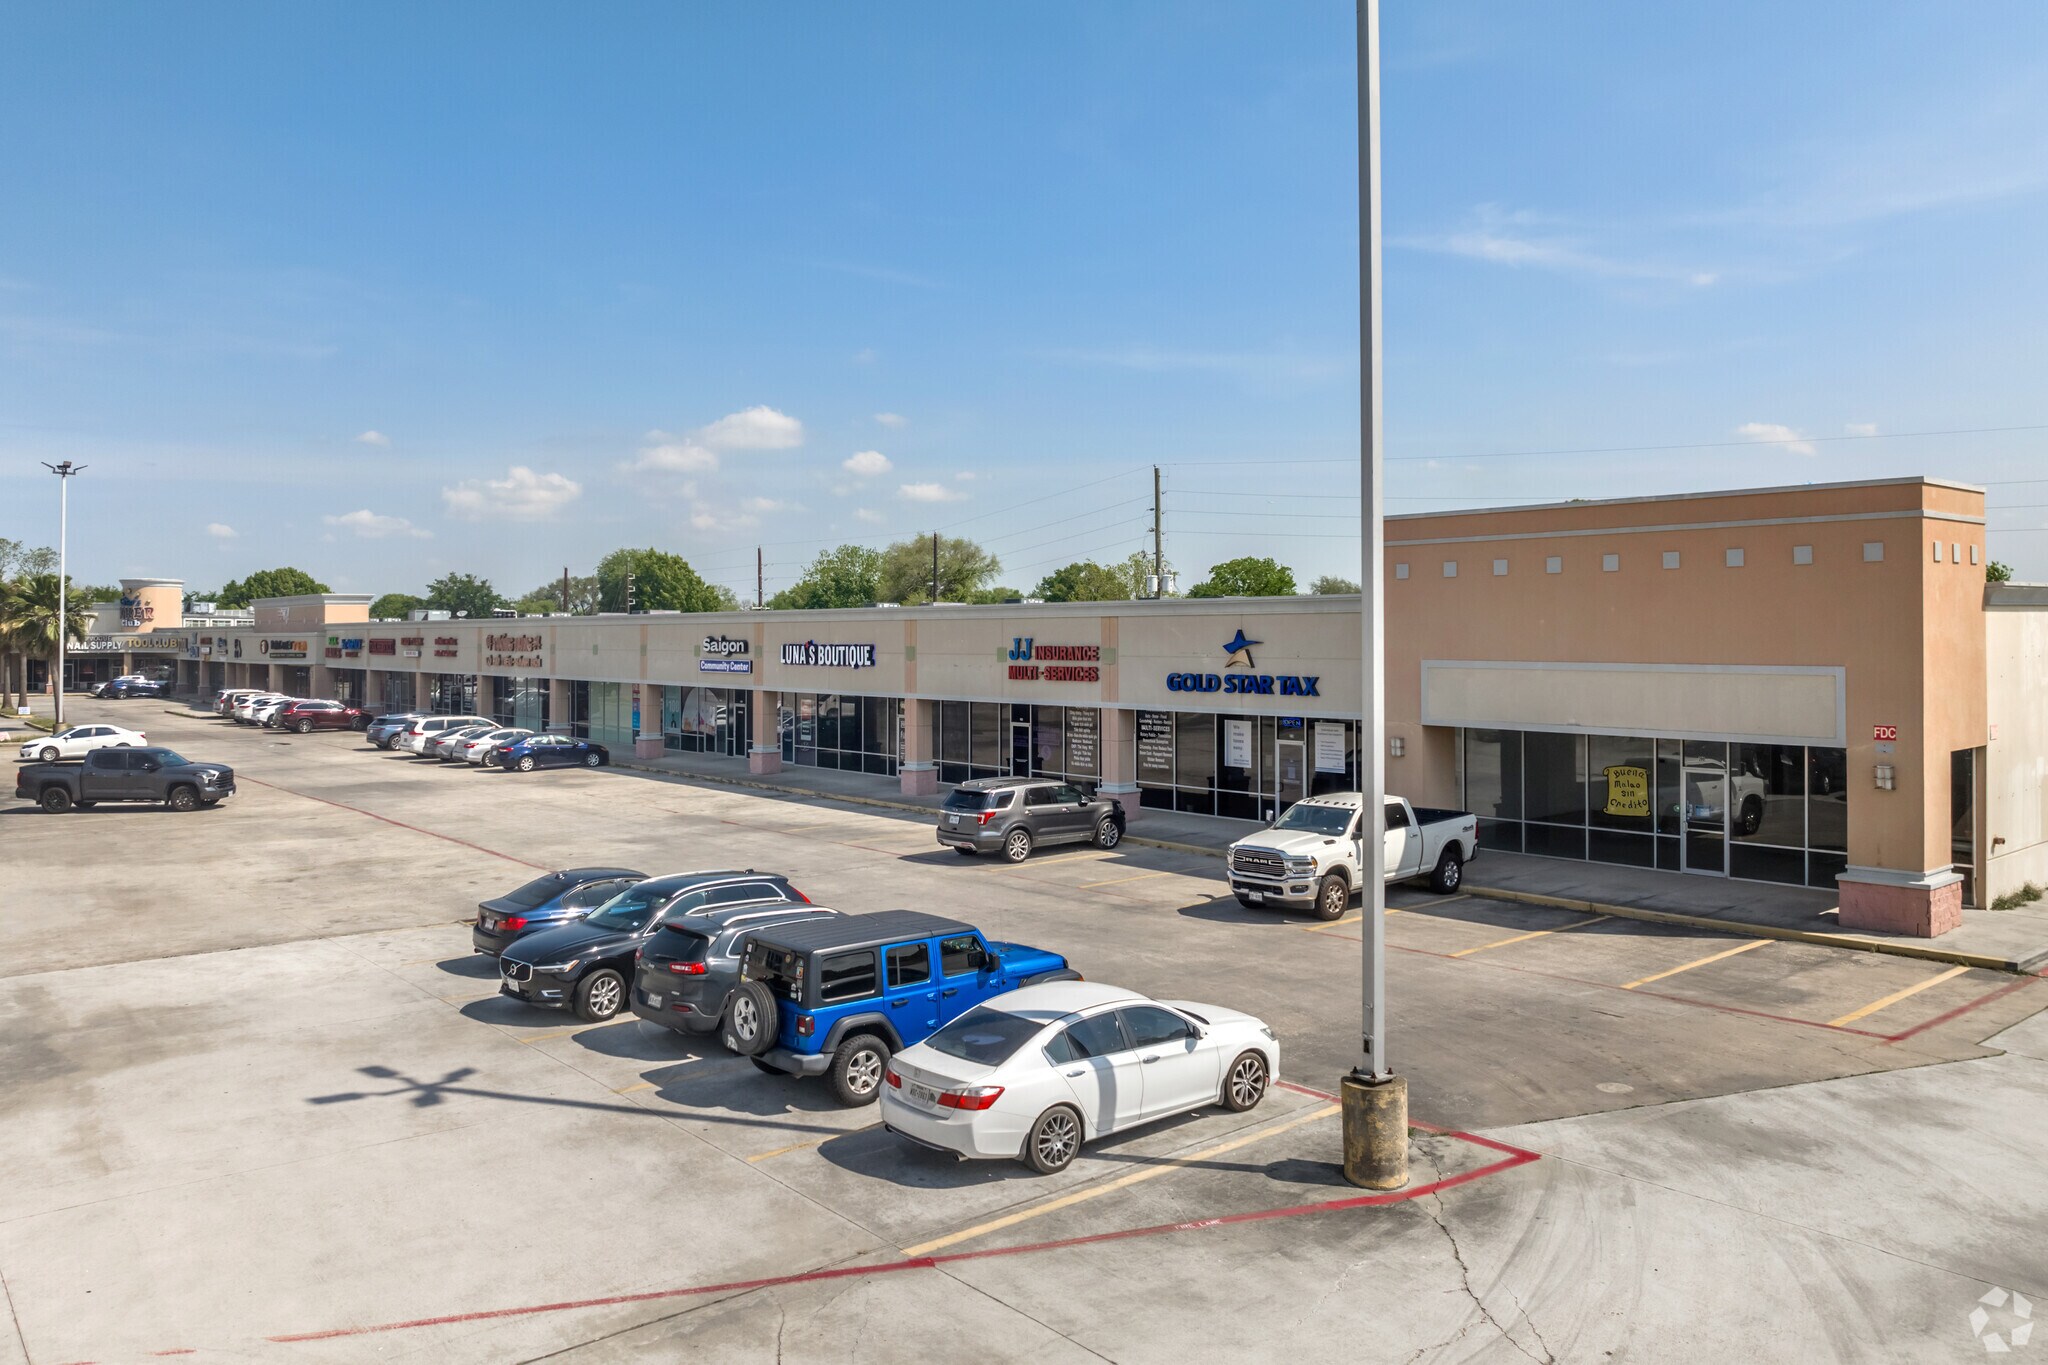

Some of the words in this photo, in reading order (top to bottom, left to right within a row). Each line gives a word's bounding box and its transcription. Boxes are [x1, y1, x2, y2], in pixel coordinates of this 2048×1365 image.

[90, 641, 122, 650] SUPPLY
[703, 636, 746, 656] Saigon
[1008, 637, 1033, 660] JJ
[1034, 645, 1099, 661] INSURANCE
[780, 642, 815, 665] LUNA'S
[818, 645, 873, 668] BOUTIQUE
[700, 660, 730, 672] Community
[730, 661, 749, 671] Center
[1166, 672, 1221, 693] GOLD
[1223, 674, 1275, 695] STAR
[1276, 675, 1320, 697] TAX
[1283, 719, 1301, 728] OPEN
[1874, 726, 1896, 739] FDC
[1613, 769, 1645, 779] Buena
